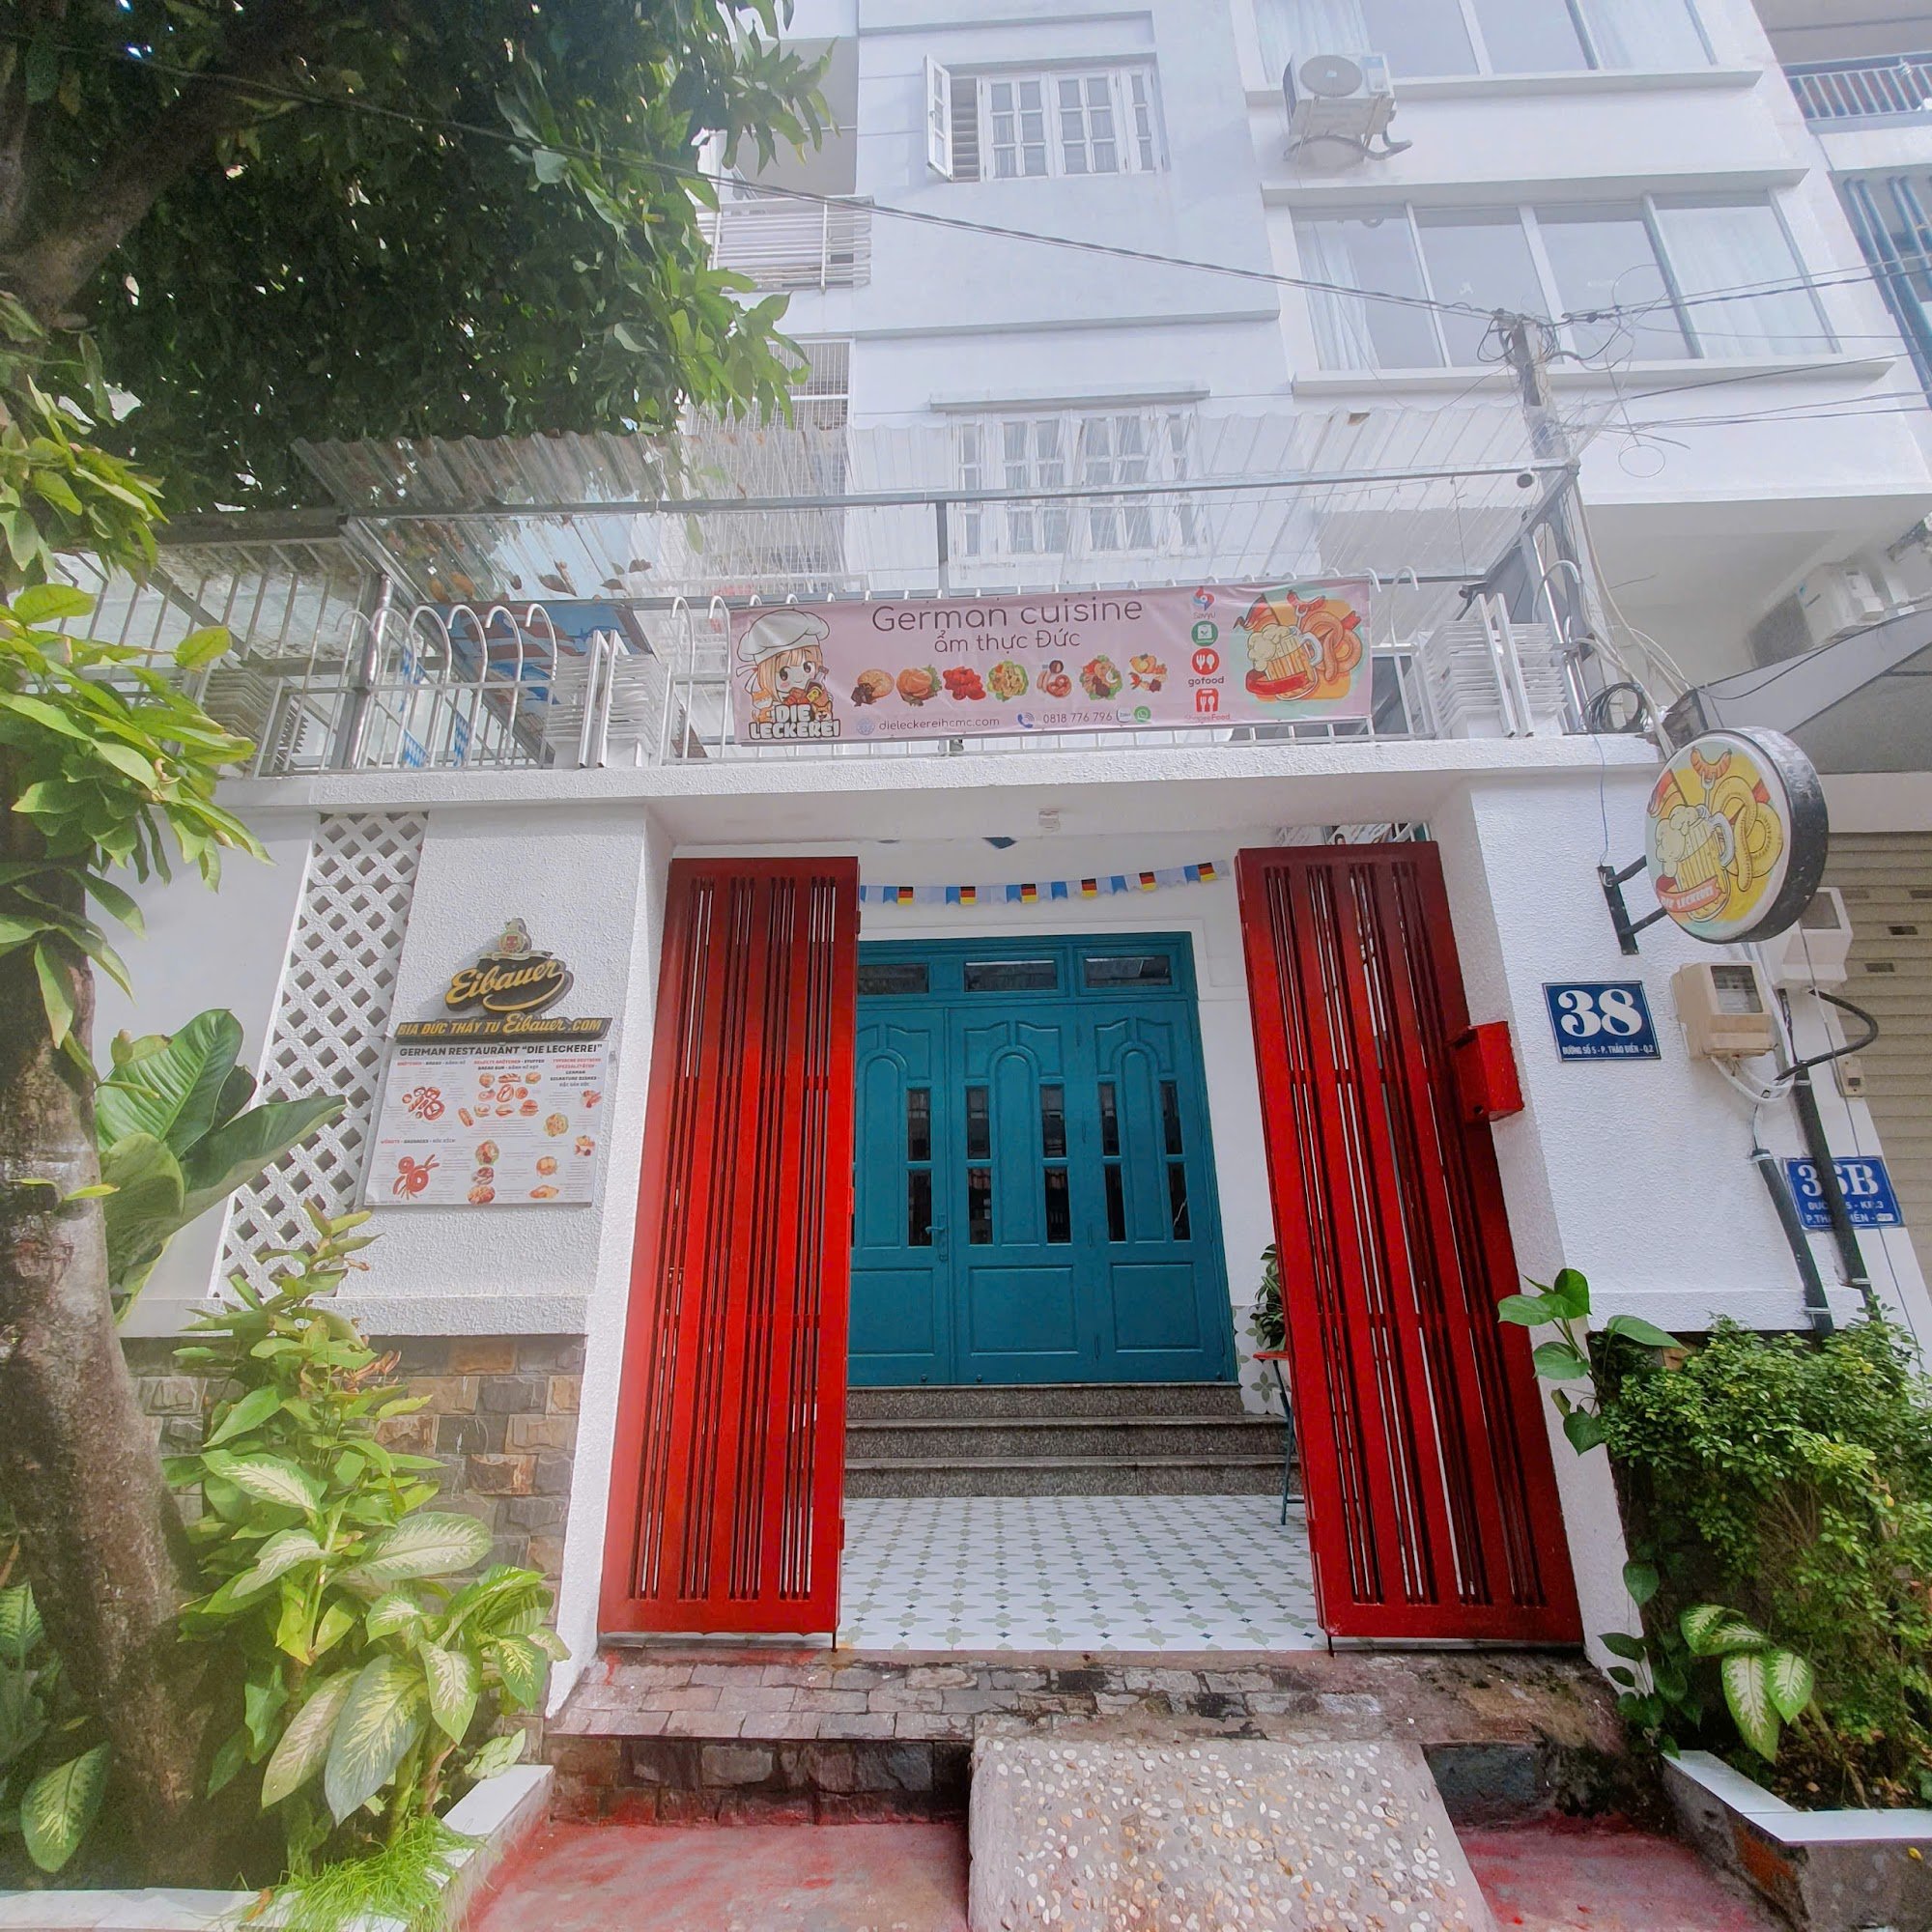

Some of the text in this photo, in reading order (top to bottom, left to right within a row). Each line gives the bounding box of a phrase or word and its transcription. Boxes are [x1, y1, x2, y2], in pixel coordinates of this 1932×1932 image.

[872, 596, 1142, 632] German cuisine
[934, 628, 1081, 654] ẩm thực Đức
[1188, 676, 1224, 687] gofood
[775, 703, 811, 723] DIE
[1043, 713, 1067, 724] 0818
[1070, 712, 1090, 723] 776
[1093, 711, 1113, 722] 796
[749, 719, 840, 739] LECKEREI
[879, 718, 1000, 730] dieleckereihcmc.com
[445, 960, 564, 1005] Eibauer
[1557, 988, 1642, 1037] 38
[397, 1024, 419, 1036] BIA
[502, 1012, 566, 1034] Eibauer
[399, 1047, 446, 1057] GERMAN
[448, 1045, 520, 1056] RESTAURANT
